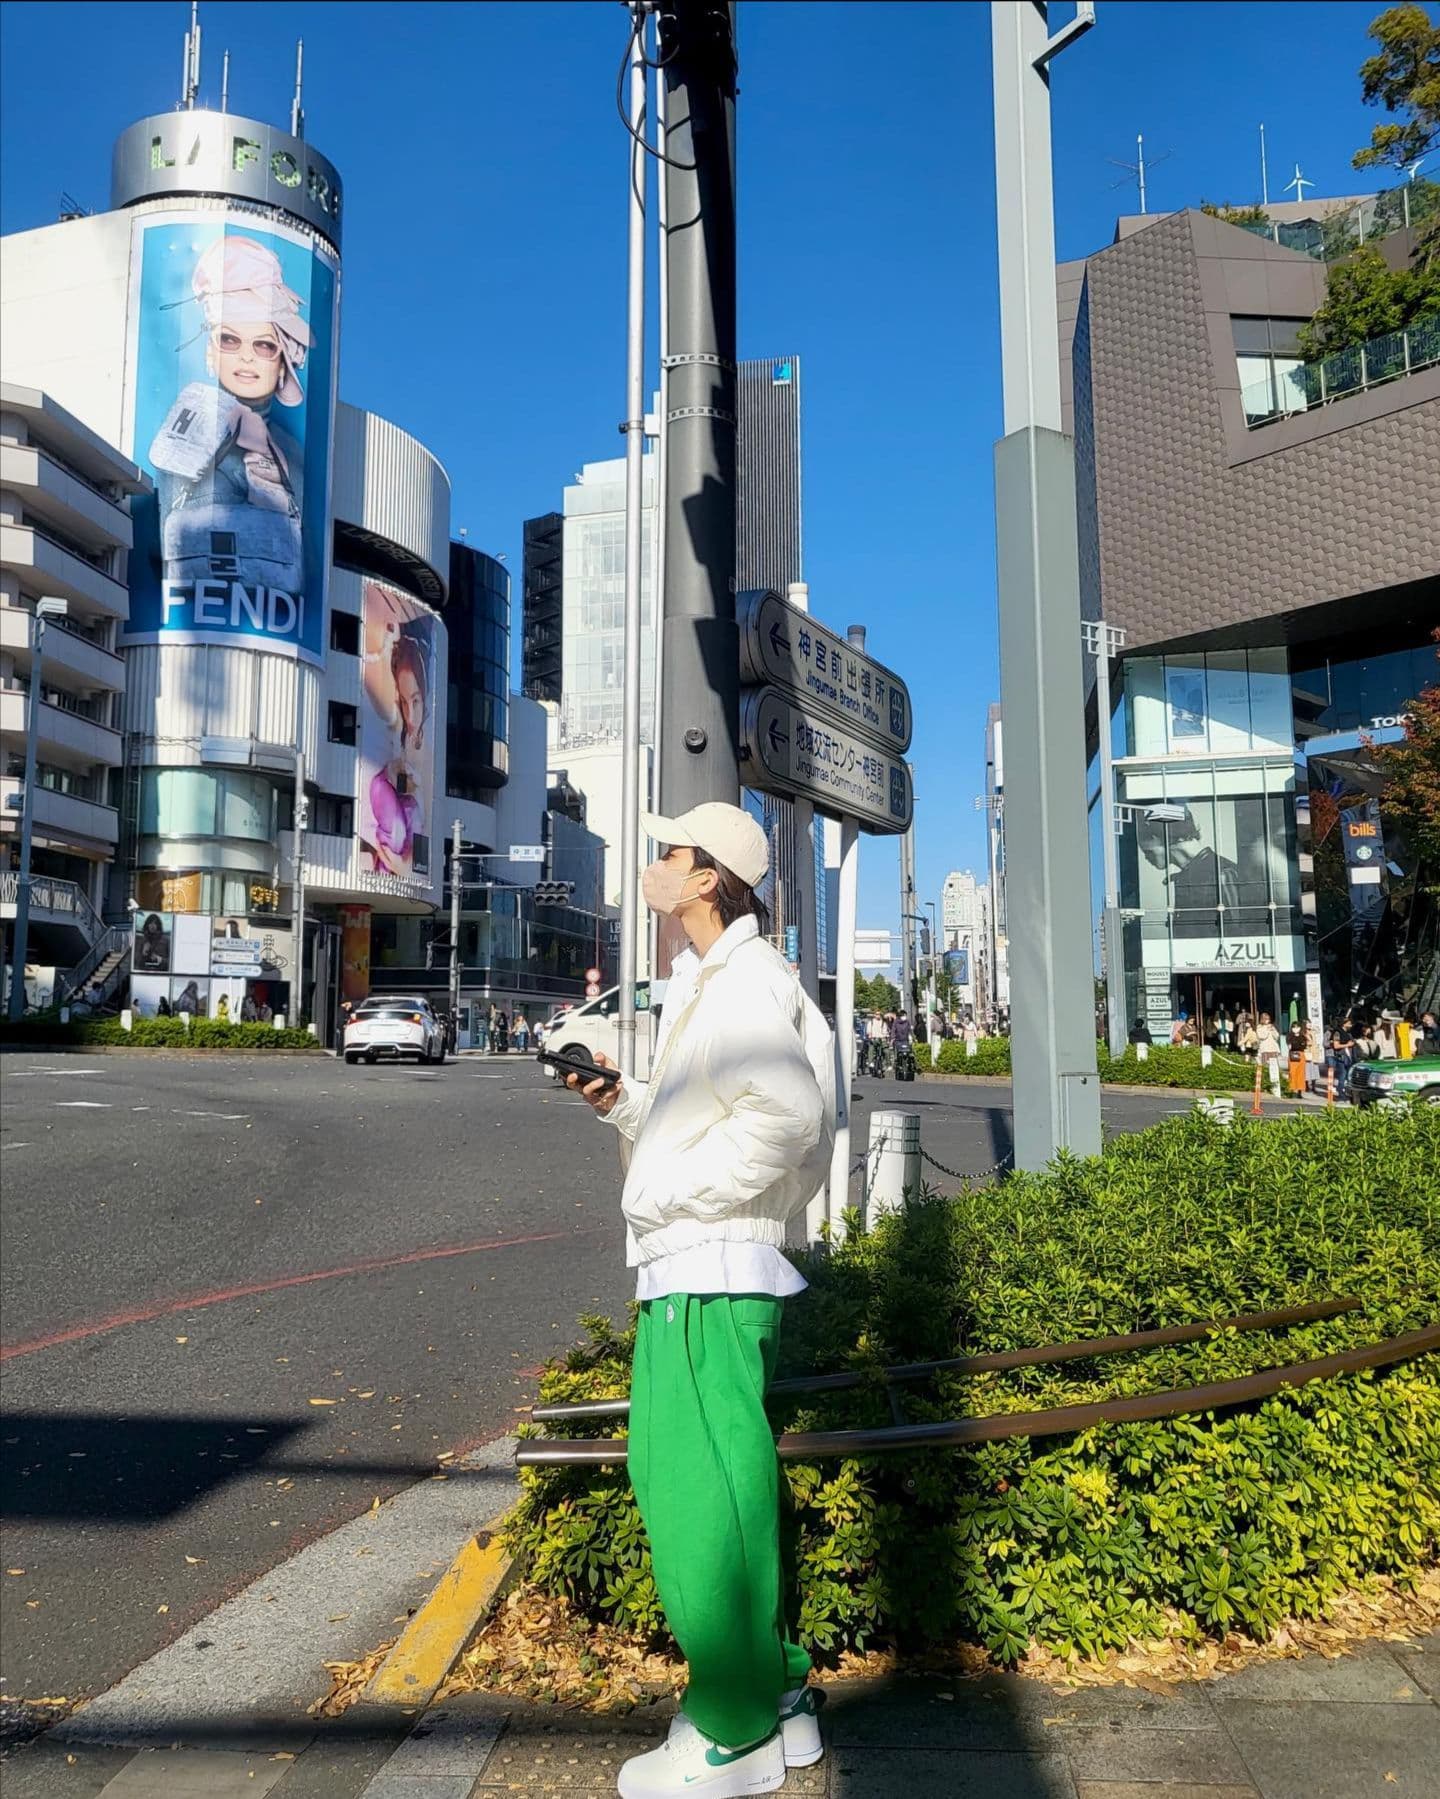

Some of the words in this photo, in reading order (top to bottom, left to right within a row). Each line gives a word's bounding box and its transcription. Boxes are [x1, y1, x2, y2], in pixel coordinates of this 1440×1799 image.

[161, 578, 305, 639] FENDI
[806, 670, 837, 701] Jingumae
[840, 688, 861, 713] Branch
[863, 702, 879, 725] Office
[831, 769, 865, 801] Community
[1349, 823, 1377, 837] bills
[1215, 942, 1275, 961] AZUL
